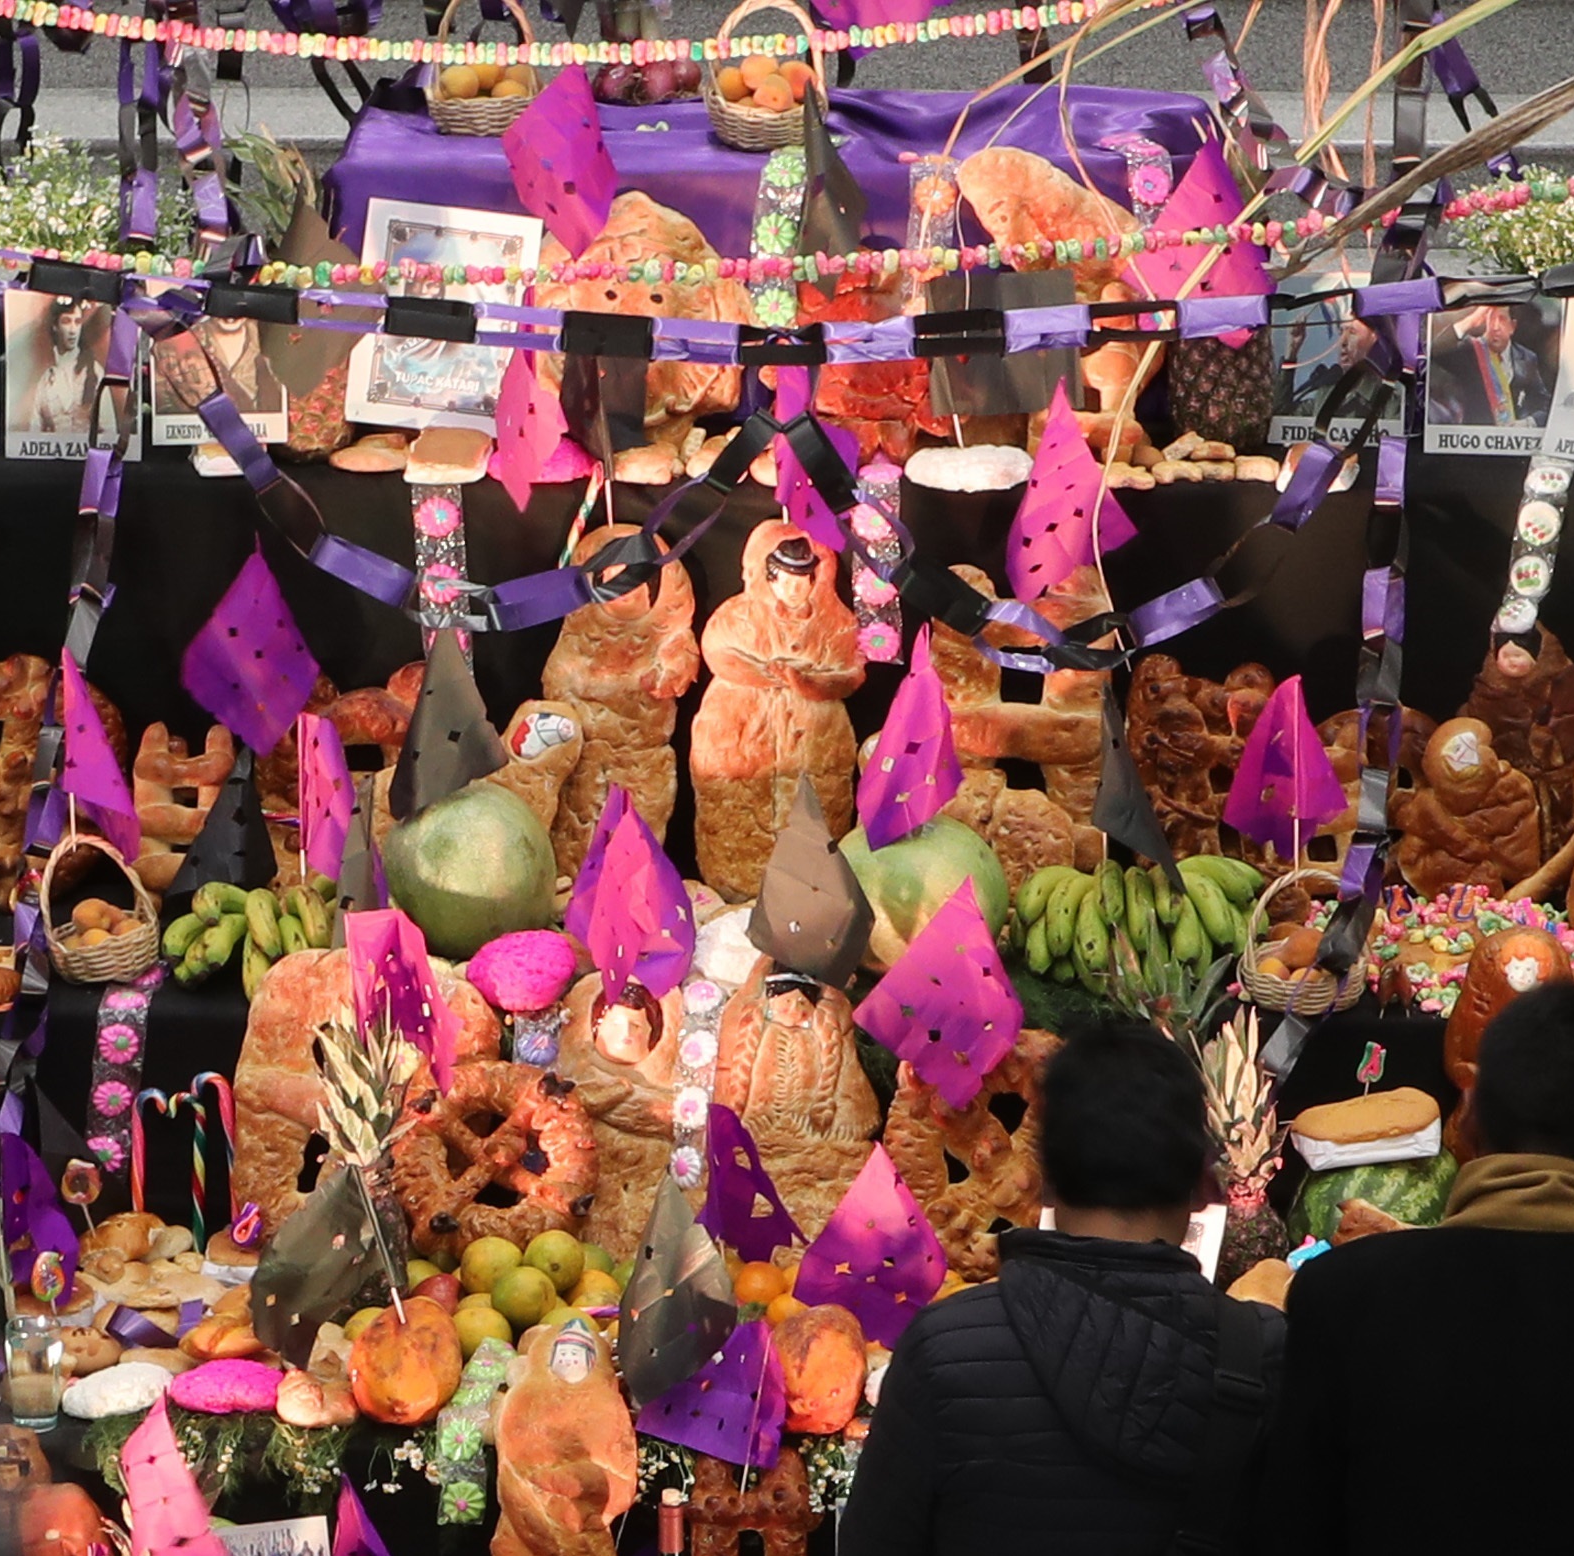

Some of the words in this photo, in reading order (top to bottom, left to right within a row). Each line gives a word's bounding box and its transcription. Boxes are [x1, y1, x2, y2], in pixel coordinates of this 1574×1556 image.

[395, 370, 433, 386] TUPAC
[434, 376, 480, 392] KATARI
[166, 424, 202, 439] ERNESTO
[19, 441, 62, 457] ADELA
[1438, 433, 1481, 449] HUGO
[1484, 435, 1543, 451] CHAVEZ
